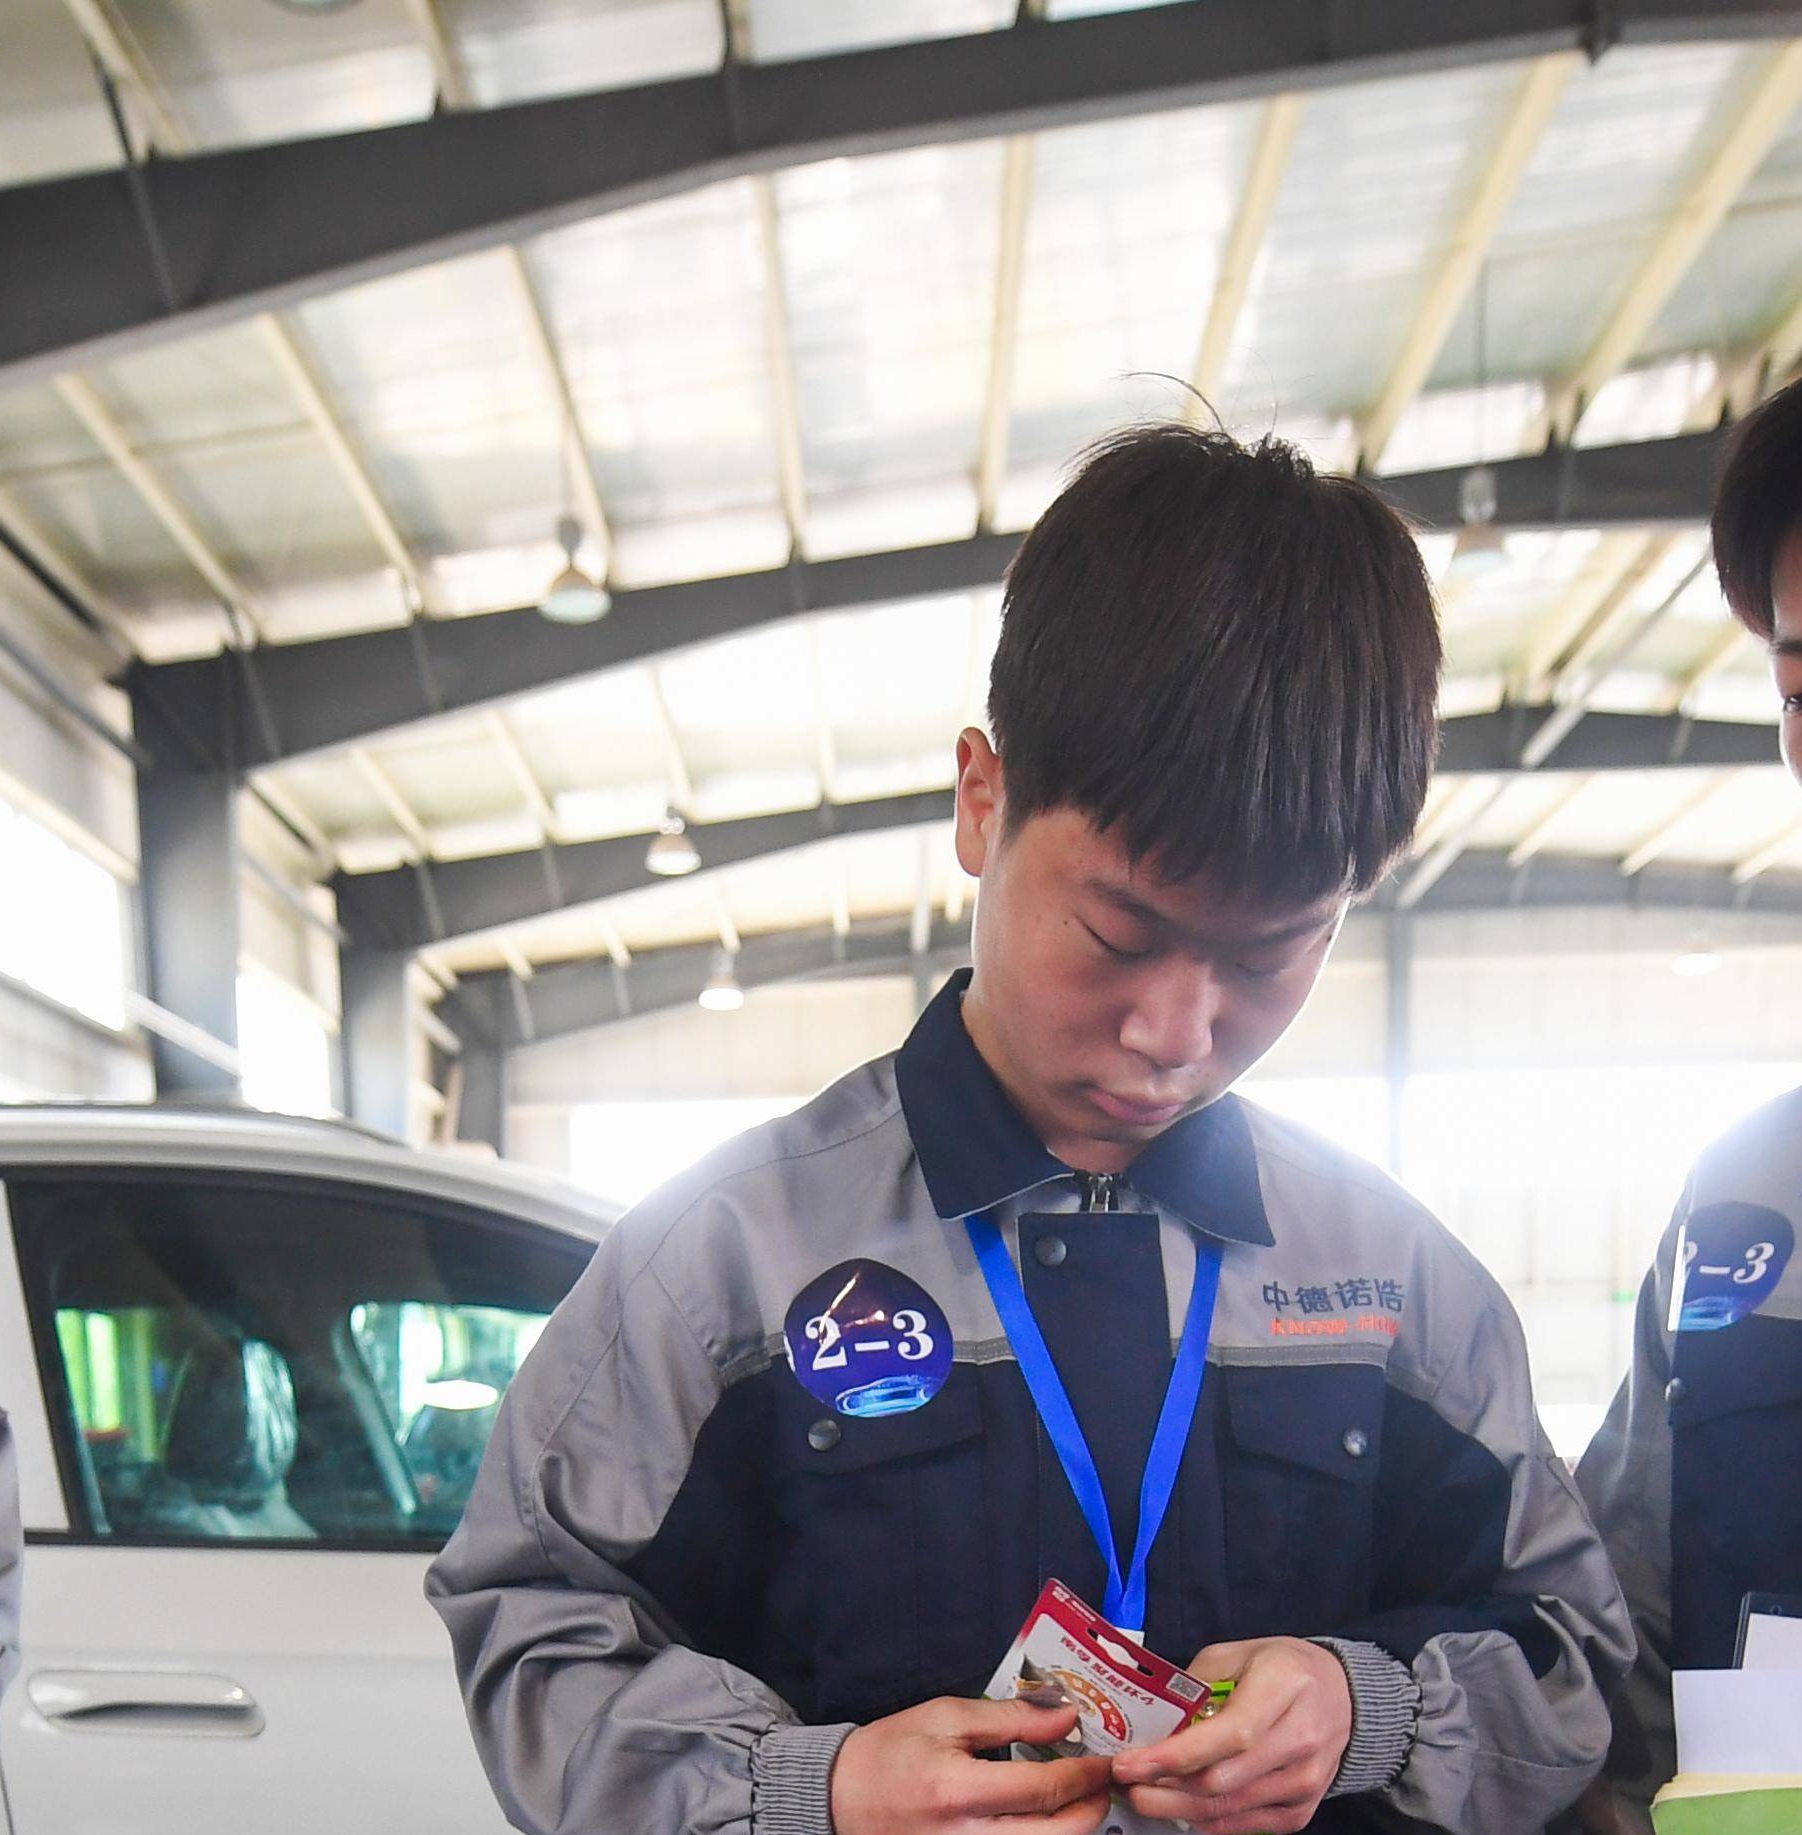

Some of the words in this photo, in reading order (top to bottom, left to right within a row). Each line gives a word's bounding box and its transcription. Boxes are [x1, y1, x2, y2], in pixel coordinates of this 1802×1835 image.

[1262, 1277, 1404, 1313] 中德诺浩
[804, 1309, 934, 1371] 2-3
